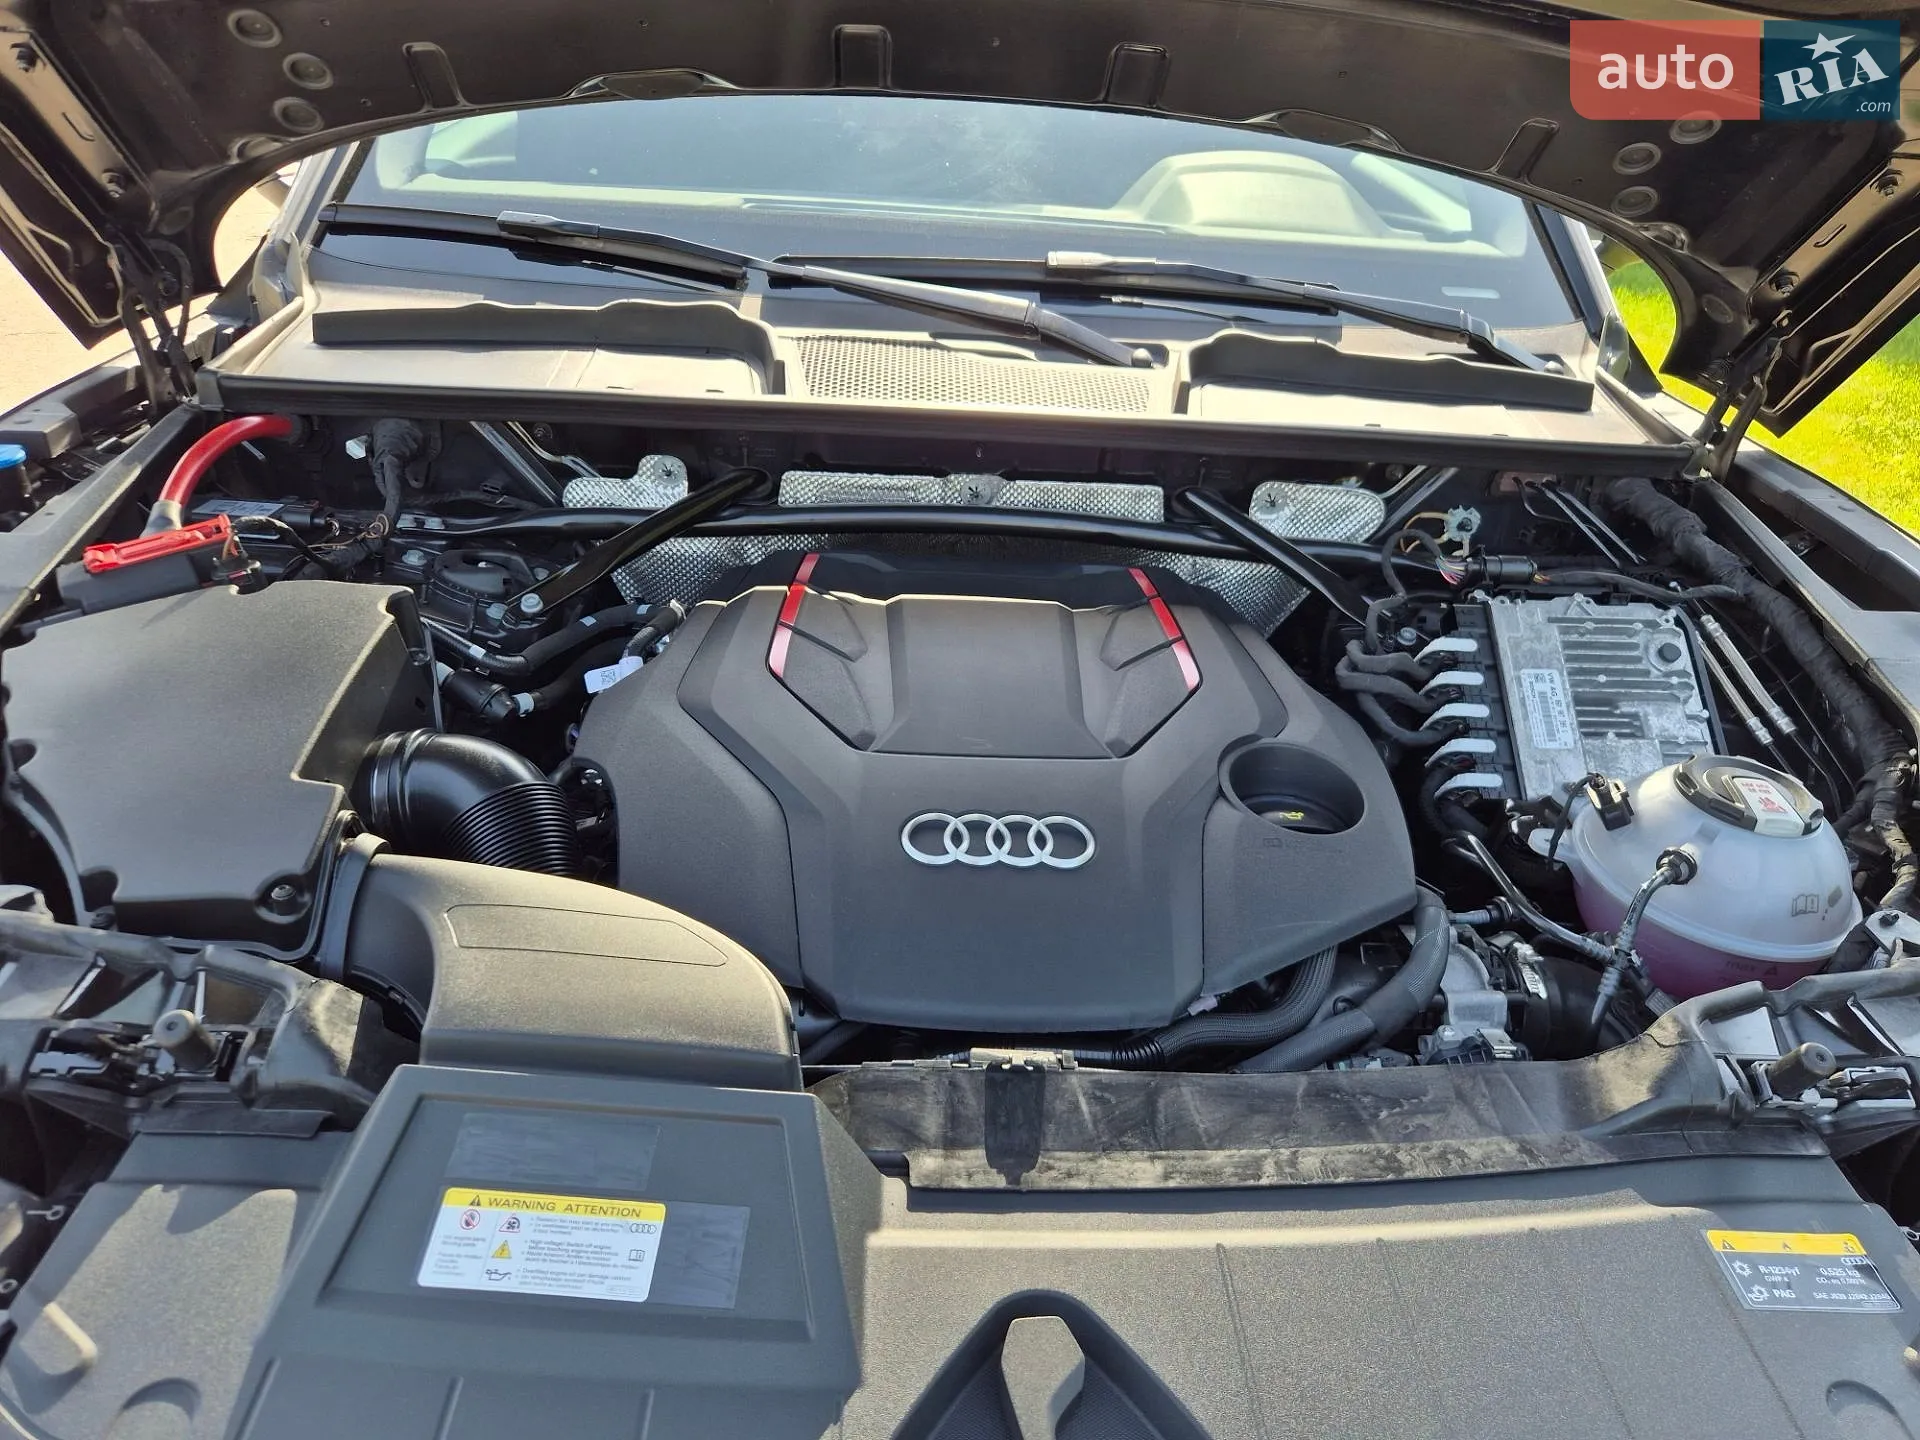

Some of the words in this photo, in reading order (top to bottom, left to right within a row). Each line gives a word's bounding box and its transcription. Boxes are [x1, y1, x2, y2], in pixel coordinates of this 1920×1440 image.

[488, 1197, 556, 1211] WARNING
[563, 1204, 642, 1218] ATTENTION
[1771, 1288, 1797, 1299] PAG
